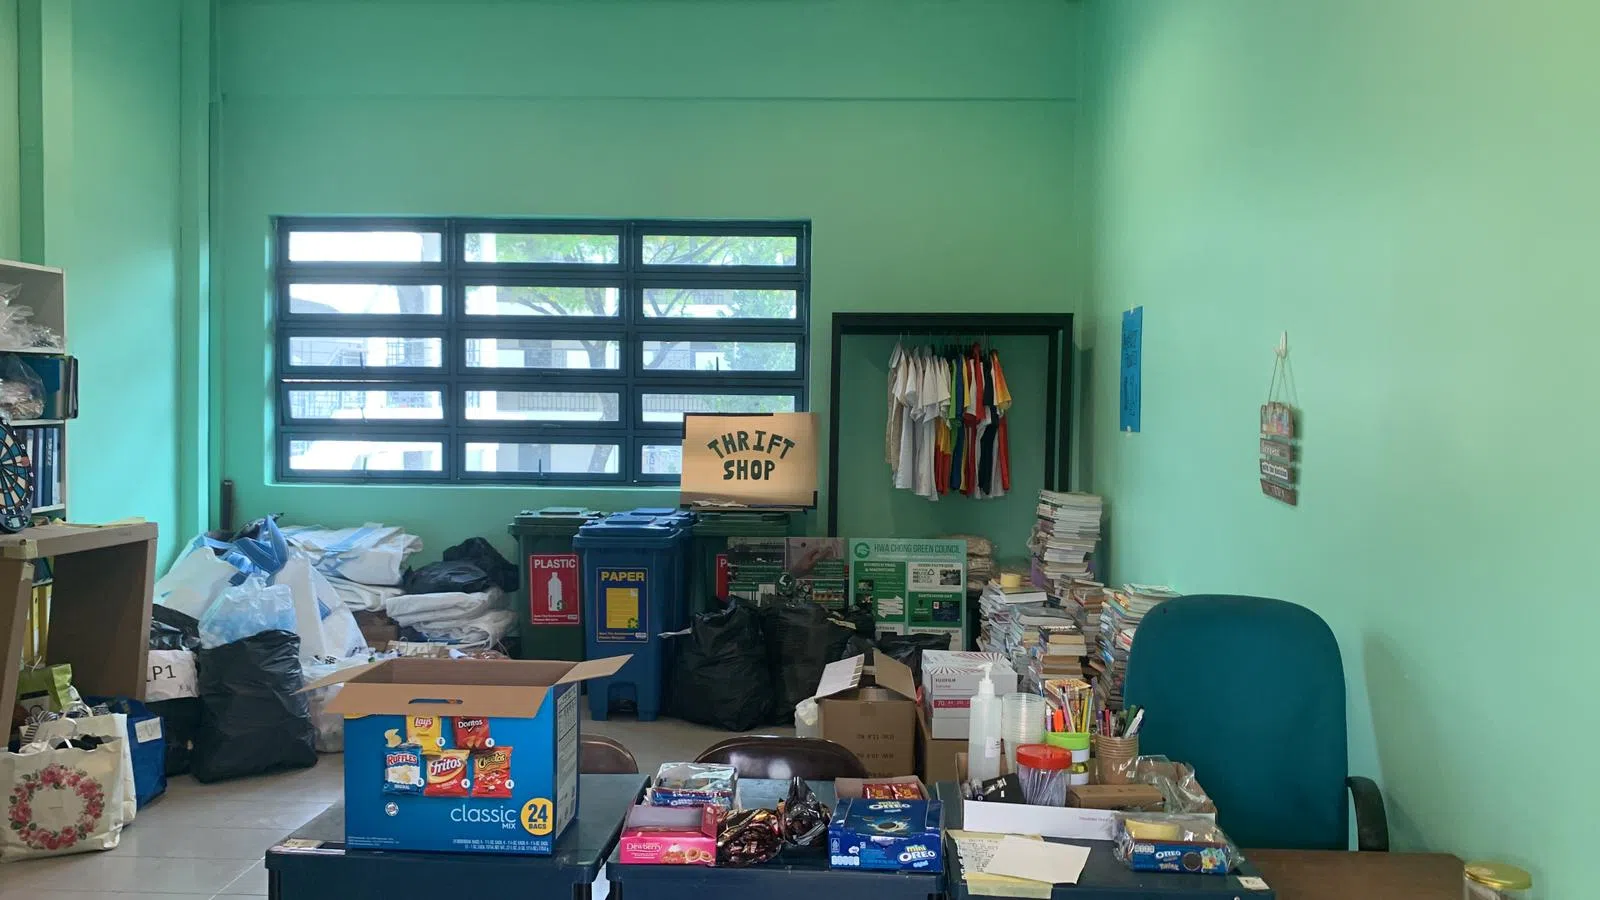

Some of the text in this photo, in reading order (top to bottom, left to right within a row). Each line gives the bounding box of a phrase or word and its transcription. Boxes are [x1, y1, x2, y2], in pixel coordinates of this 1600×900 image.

[707, 430, 796, 459] THRIFT
[723, 460, 775, 480] SHOP
[874, 544, 961, 554] HWA CHONG GREEN COUNCIL
[534, 559, 576, 569] PLASTIC
[601, 571, 645, 581] PAPER
[457, 719, 483, 729] Doritos
[387, 753, 418, 765] RUFFLES
[450, 804, 517, 824] classic
[528, 804, 548, 822] 24
[626, 842, 663, 851] Dewberry
[899, 850, 936, 862] OREO
[1156, 850, 1181, 859] OREO
